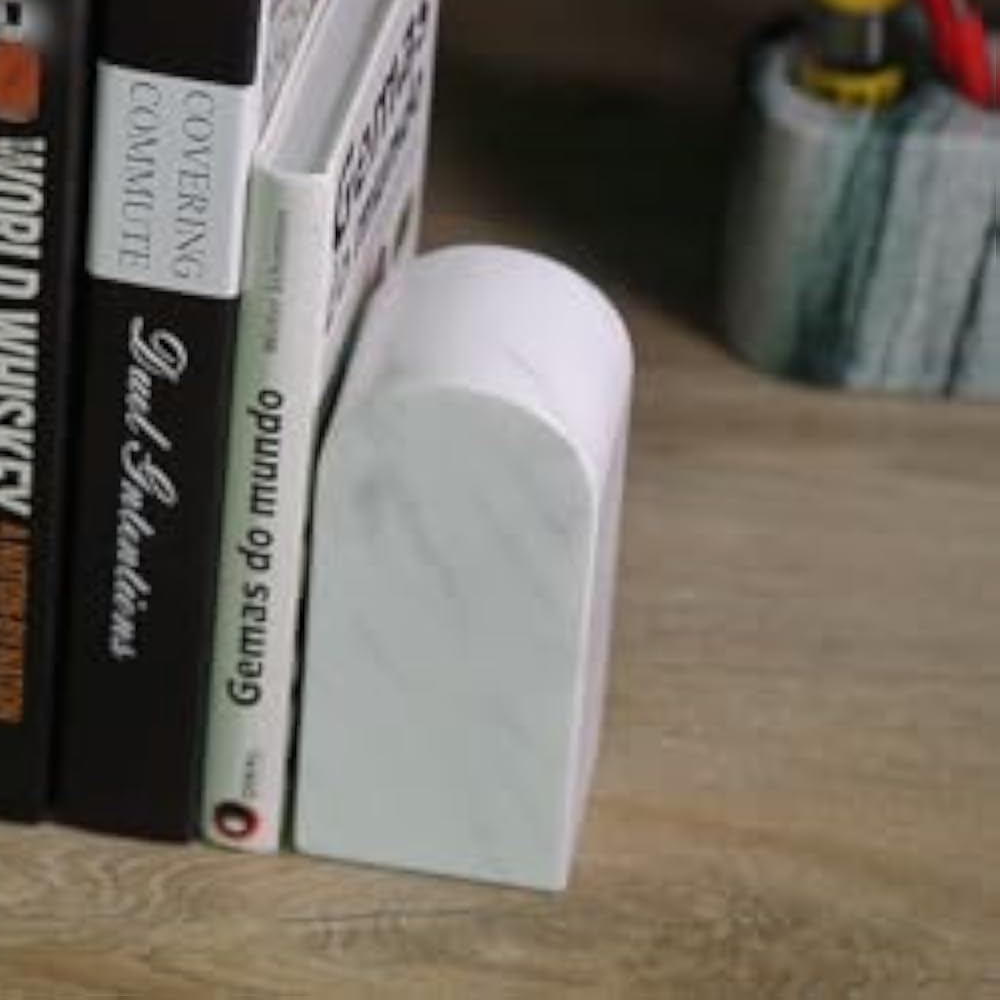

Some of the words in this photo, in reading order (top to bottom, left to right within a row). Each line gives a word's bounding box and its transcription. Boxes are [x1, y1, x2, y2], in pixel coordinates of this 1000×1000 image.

[118, 81, 161, 272] COMMUTE
[173, 90, 215, 280] COVERING
[246, 388, 284, 518] mundo
[237, 528, 275, 572] do
[226, 580, 271, 707] Gemas
